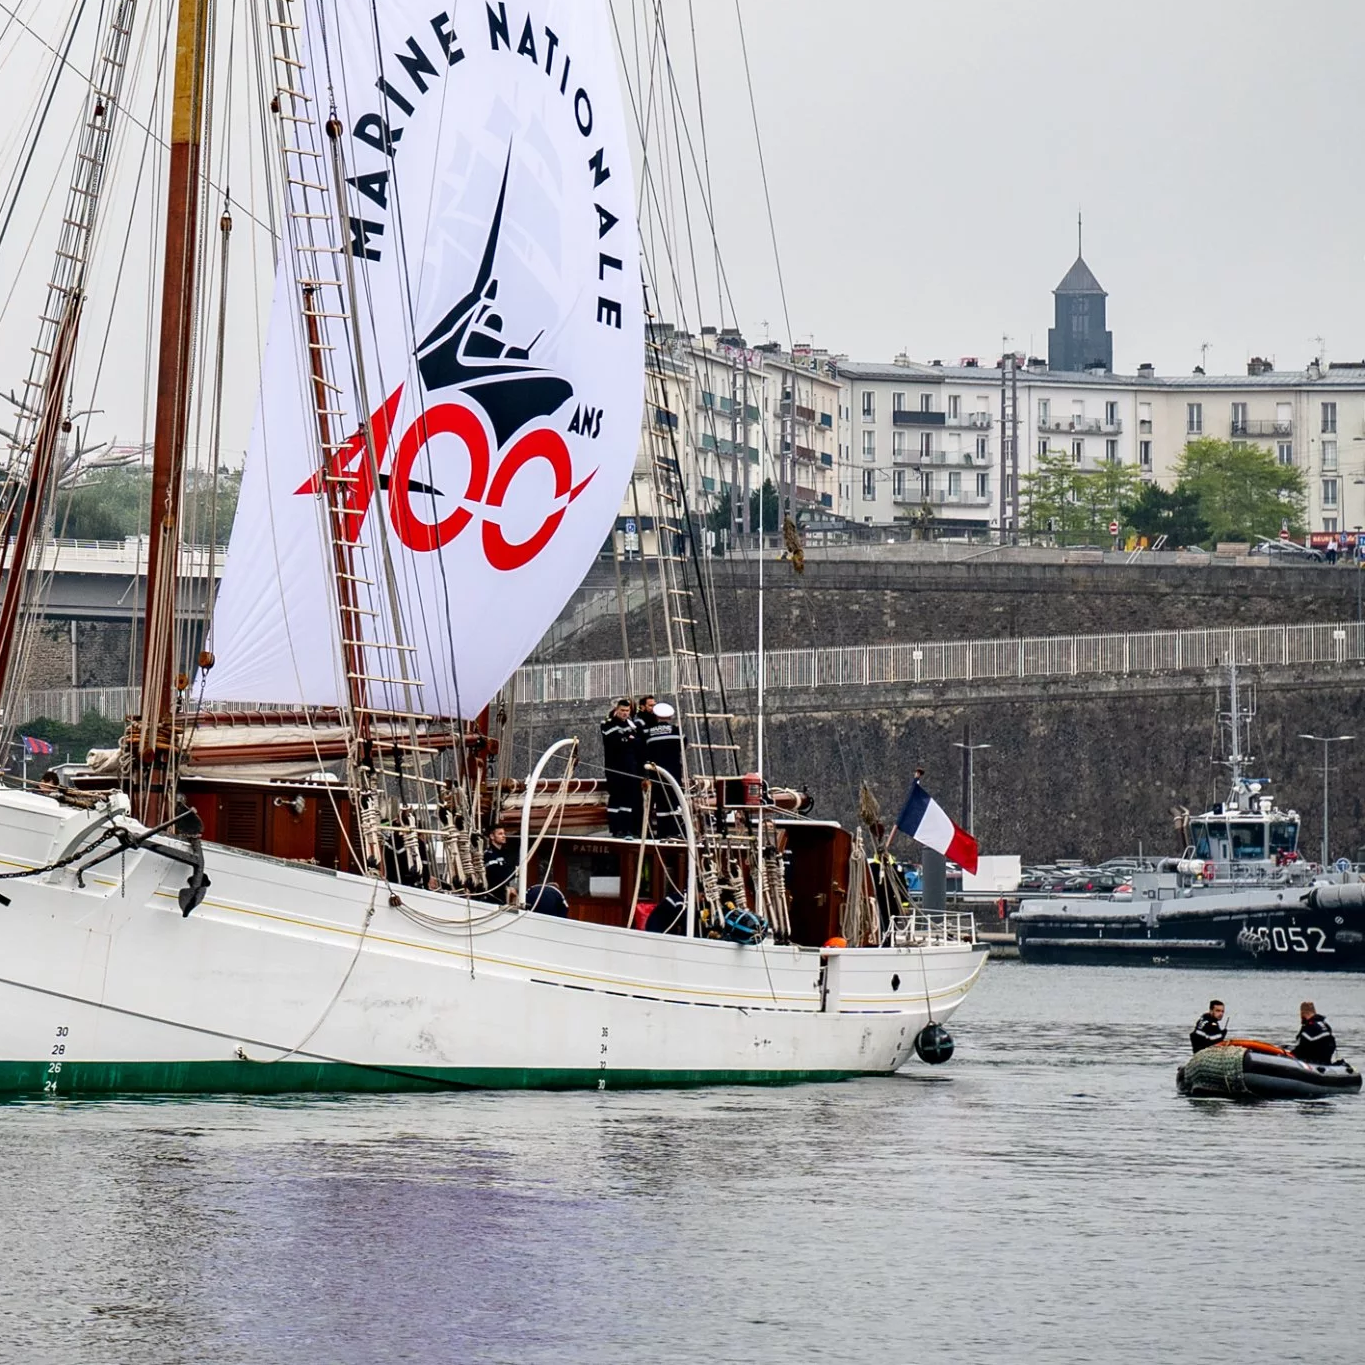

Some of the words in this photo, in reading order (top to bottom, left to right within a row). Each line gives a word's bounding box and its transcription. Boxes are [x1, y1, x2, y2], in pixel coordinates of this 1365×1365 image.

[340, 11, 466, 262] MARINE
[485, 0, 623, 329] NATIONALE
[567, 402, 604, 439] ANS
[292, 381, 600, 571] 400
[572, 844, 610, 854] PATRIE
[56, 1026, 69, 1037] 30
[51, 1045, 65, 1055] 28
[48, 1063, 62, 1073] 26
[44, 1081, 57, 1091] 24
